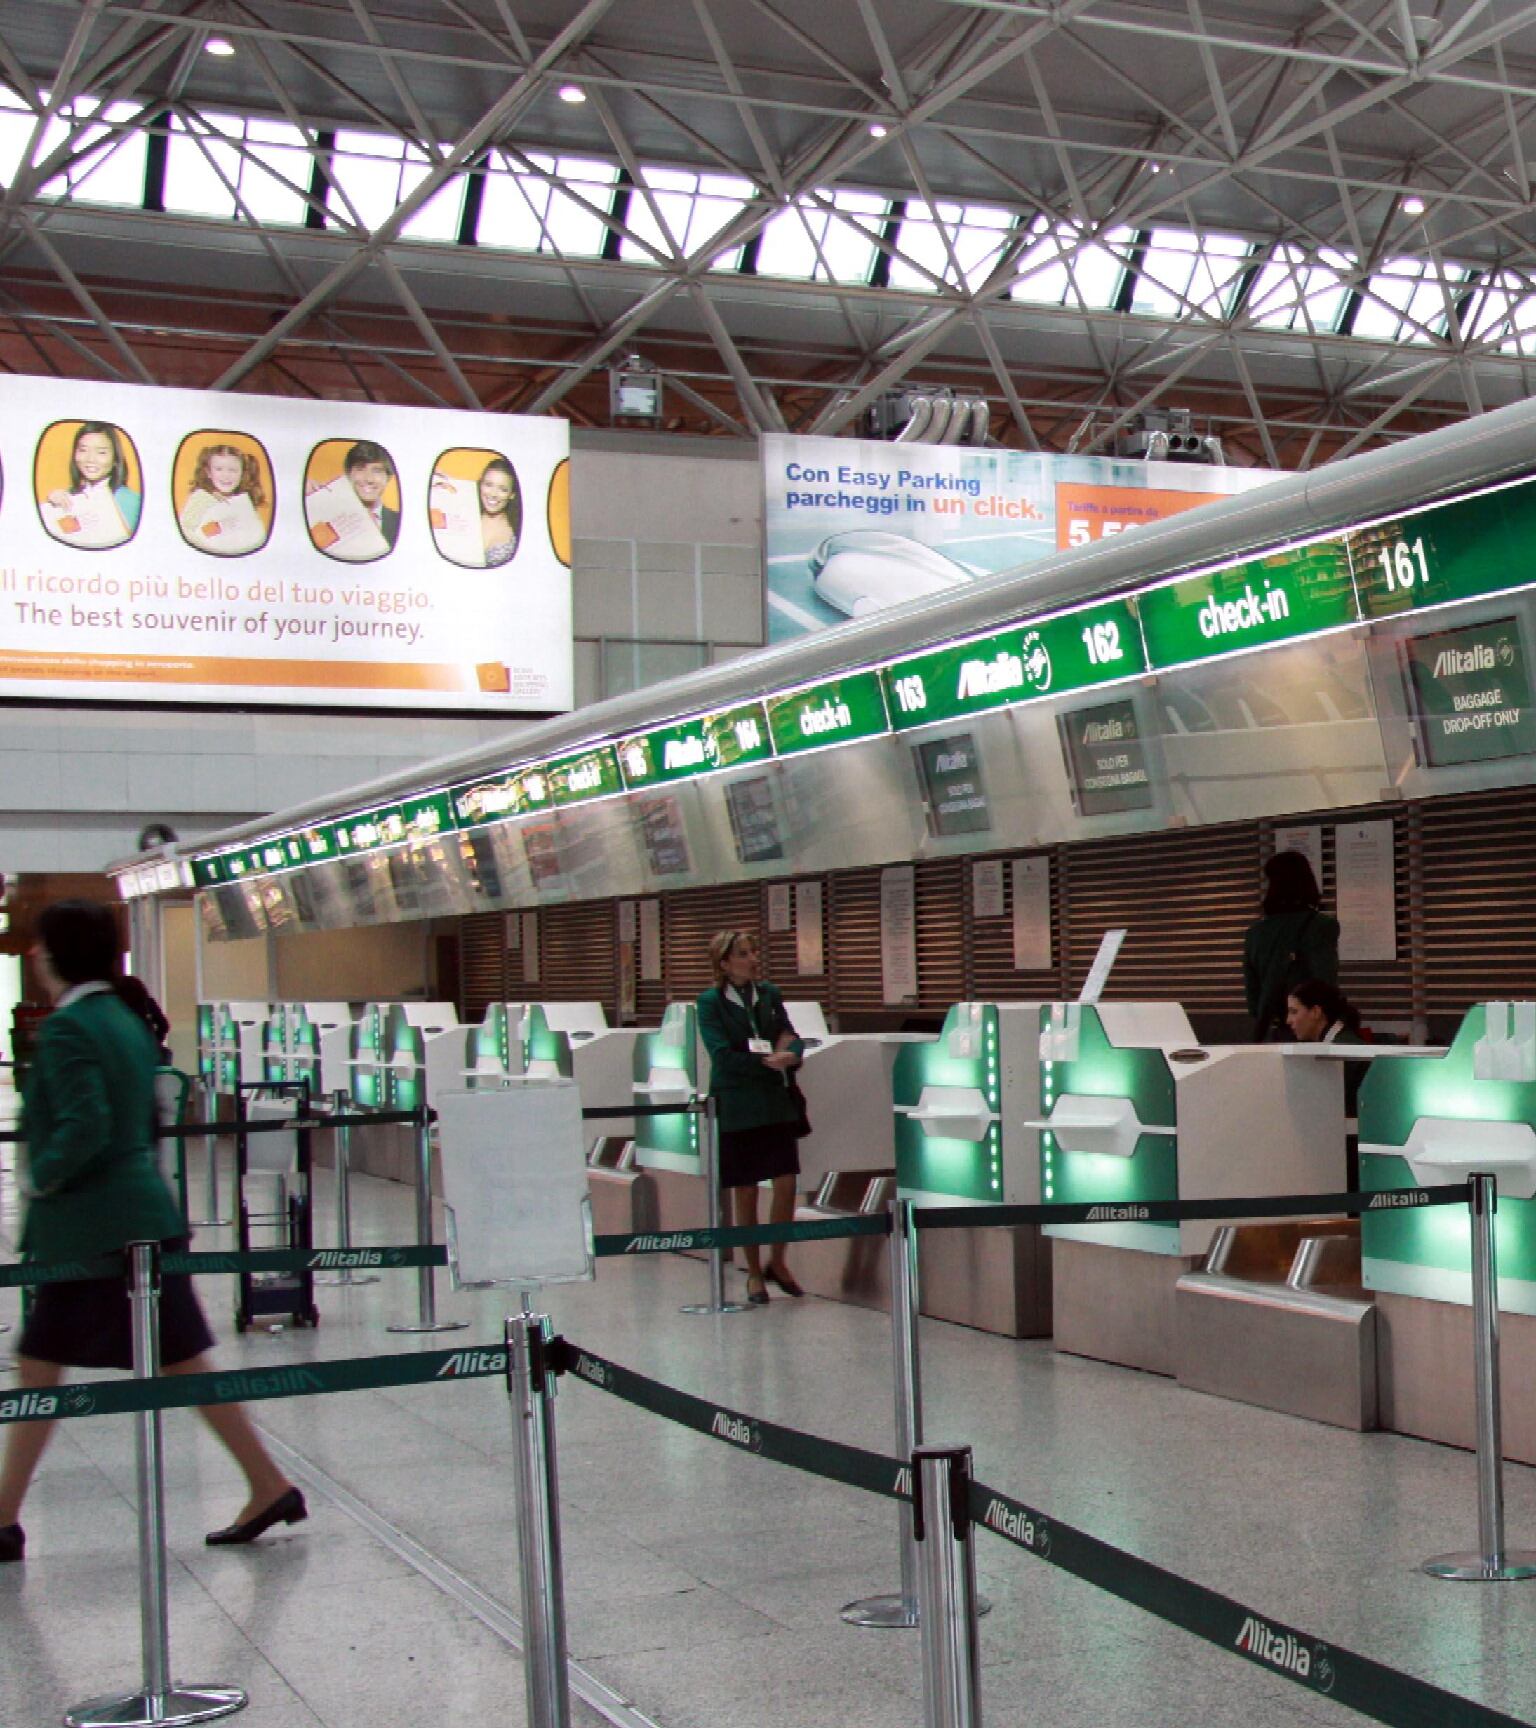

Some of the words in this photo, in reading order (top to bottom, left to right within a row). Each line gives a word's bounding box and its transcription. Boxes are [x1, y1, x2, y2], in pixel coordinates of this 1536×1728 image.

[786, 463, 830, 482] Con
[838, 467, 890, 490] Easy
[898, 471, 980, 496] Parking
[786, 492, 899, 513] parcheggi
[906, 495, 926, 511] in
[932, 498, 965, 514] un
[973, 497, 1044, 520] click.
[1378, 537, 1430, 592] 161
[1, 569, 16, 591] Il
[27, 570, 120, 596] ricordo
[129, 575, 168, 602] più
[178, 576, 240, 601] bello
[248, 580, 284, 603] del
[292, 584, 334, 605] tuo
[341, 587, 435, 614] viaggio.
[15, 602, 63, 627] The
[71, 604, 123, 629] best
[132, 610, 236, 633] souvenir
[244, 611, 269, 634] of
[273, 617, 328, 640] your
[332, 616, 425, 646] journey.
[1199, 584, 1288, 640] check-in
[1082, 620, 1123, 664] 162
[957, 652, 1024, 700] Alitalia
[1432, 644, 1495, 679] Alitalia
[895, 674, 927, 712] 163
[1453, 689, 1503, 713] BAGGAGE
[800, 697, 851, 736] check-in
[1082, 719, 1123, 745] Alitalia
[1443, 715, 1493, 735] DROP-OFF
[1493, 708, 1521, 726] ONLY
[1085, 1205, 1149, 1220] Alitalia
[1368, 1190, 1430, 1208] Alitalia
[307, 1248, 382, 1268] Alitalia
[624, 1233, 694, 1252] Alitalia
[437, 1352, 507, 1377] Alita
[577, 1353, 605, 1385] Alitalia
[0, 1393, 58, 1418] alia
[712, 1411, 751, 1444] Alitalia
[984, 1499, 1035, 1547] Alitalia
[1235, 1616, 1311, 1675] Alitalia
